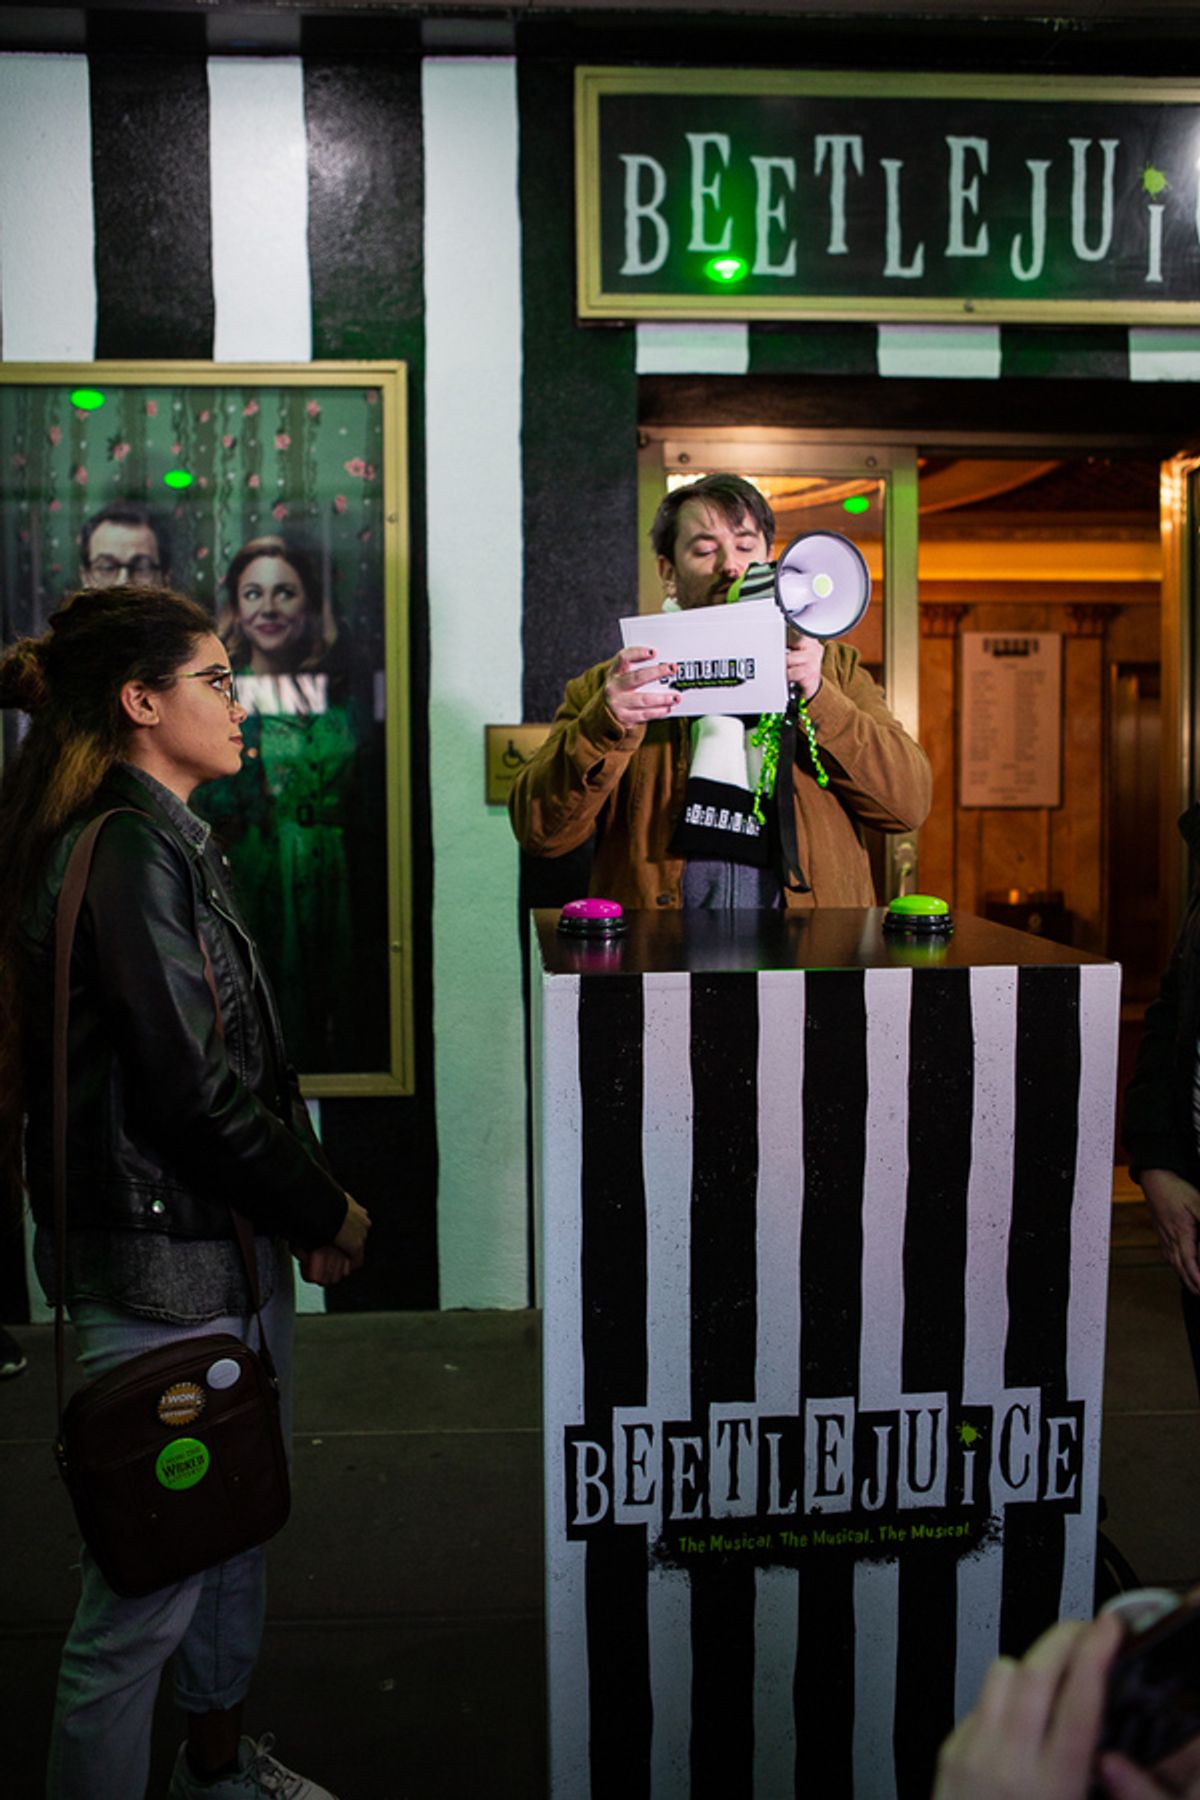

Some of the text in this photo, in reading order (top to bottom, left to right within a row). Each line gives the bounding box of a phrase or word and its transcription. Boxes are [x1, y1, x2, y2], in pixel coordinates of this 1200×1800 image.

[679, 1536, 706, 1553] The
[780, 1531, 808, 1548] The
[879, 1525, 906, 1541] The
